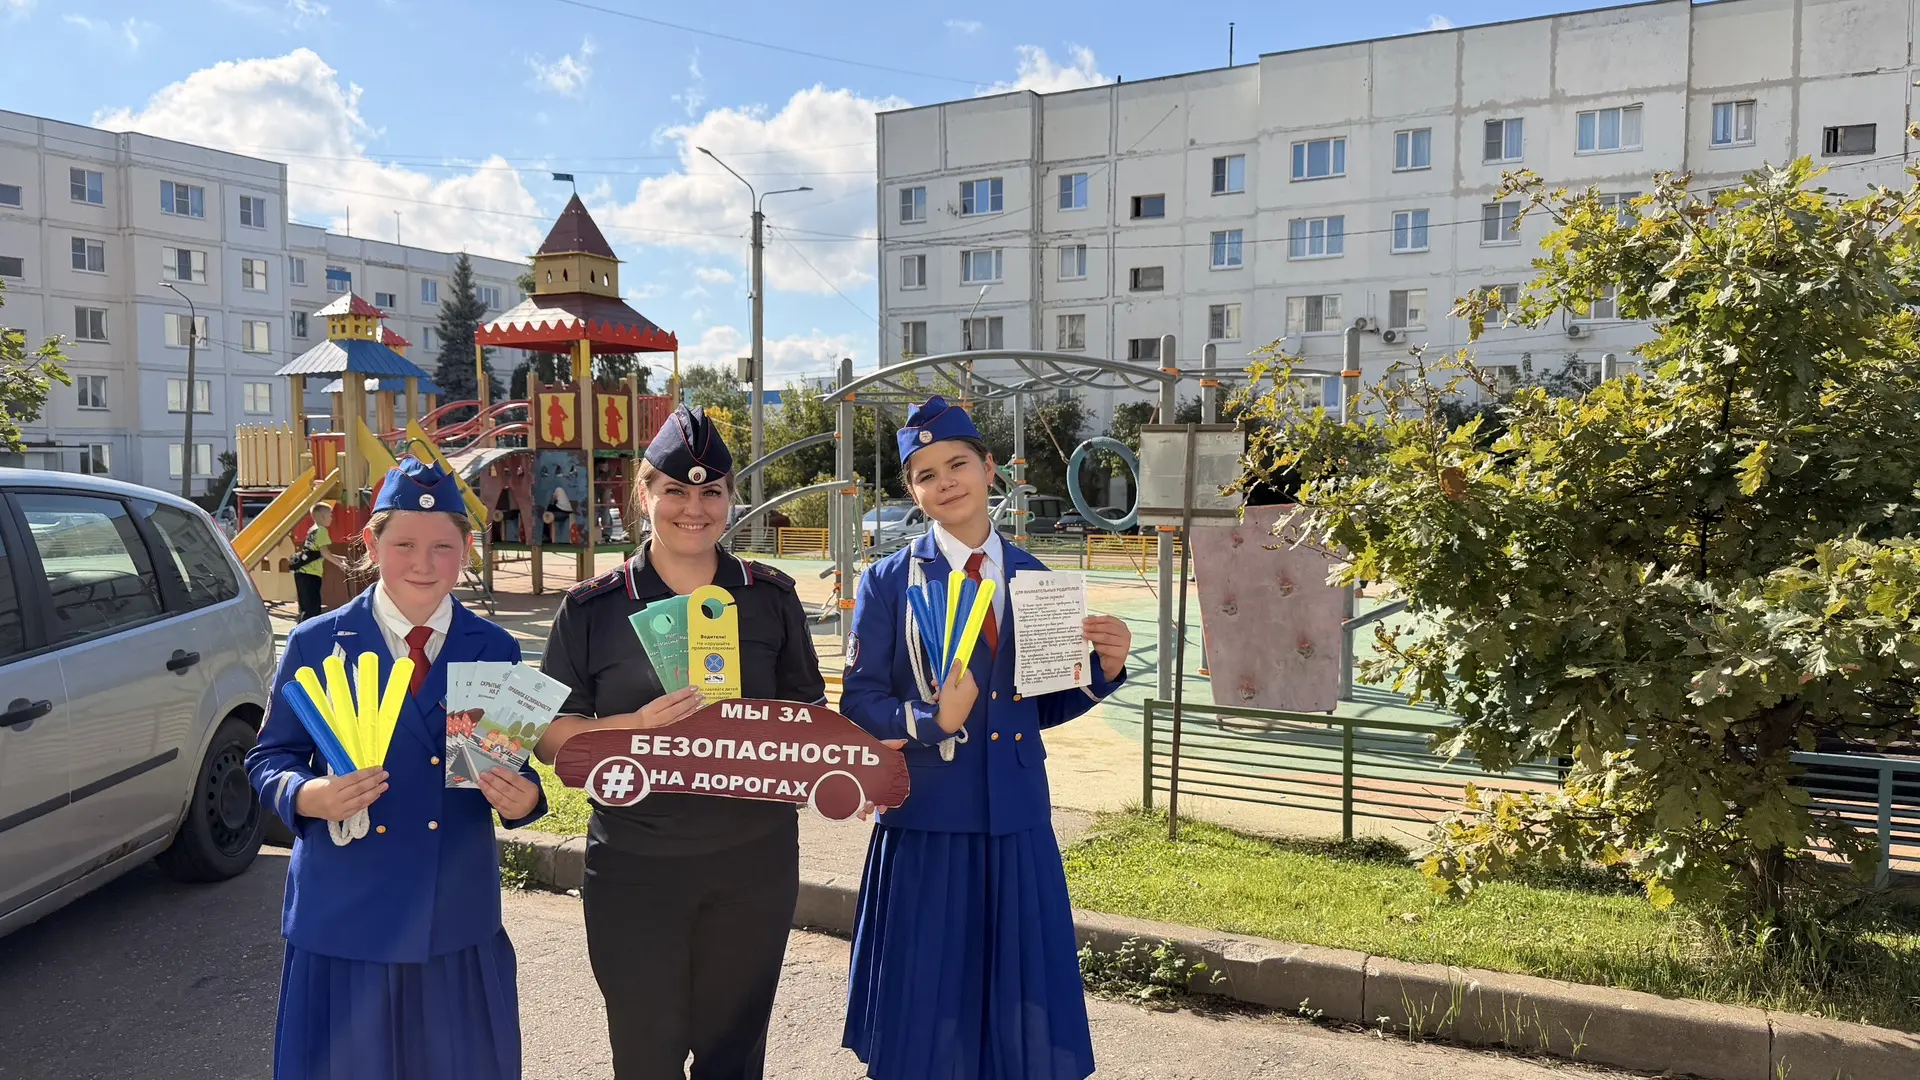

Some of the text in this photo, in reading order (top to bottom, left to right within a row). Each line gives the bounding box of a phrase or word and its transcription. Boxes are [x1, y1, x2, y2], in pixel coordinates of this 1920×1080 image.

[507, 685, 525, 698] ПРАВИЛА
[721, 703, 813, 723] МЫ ЗА
[630, 734, 880, 766] БЕЗОПАСНОСТЬ
[649, 769, 685, 786] НА
[691, 772, 809, 797] ДОРОГАХ
